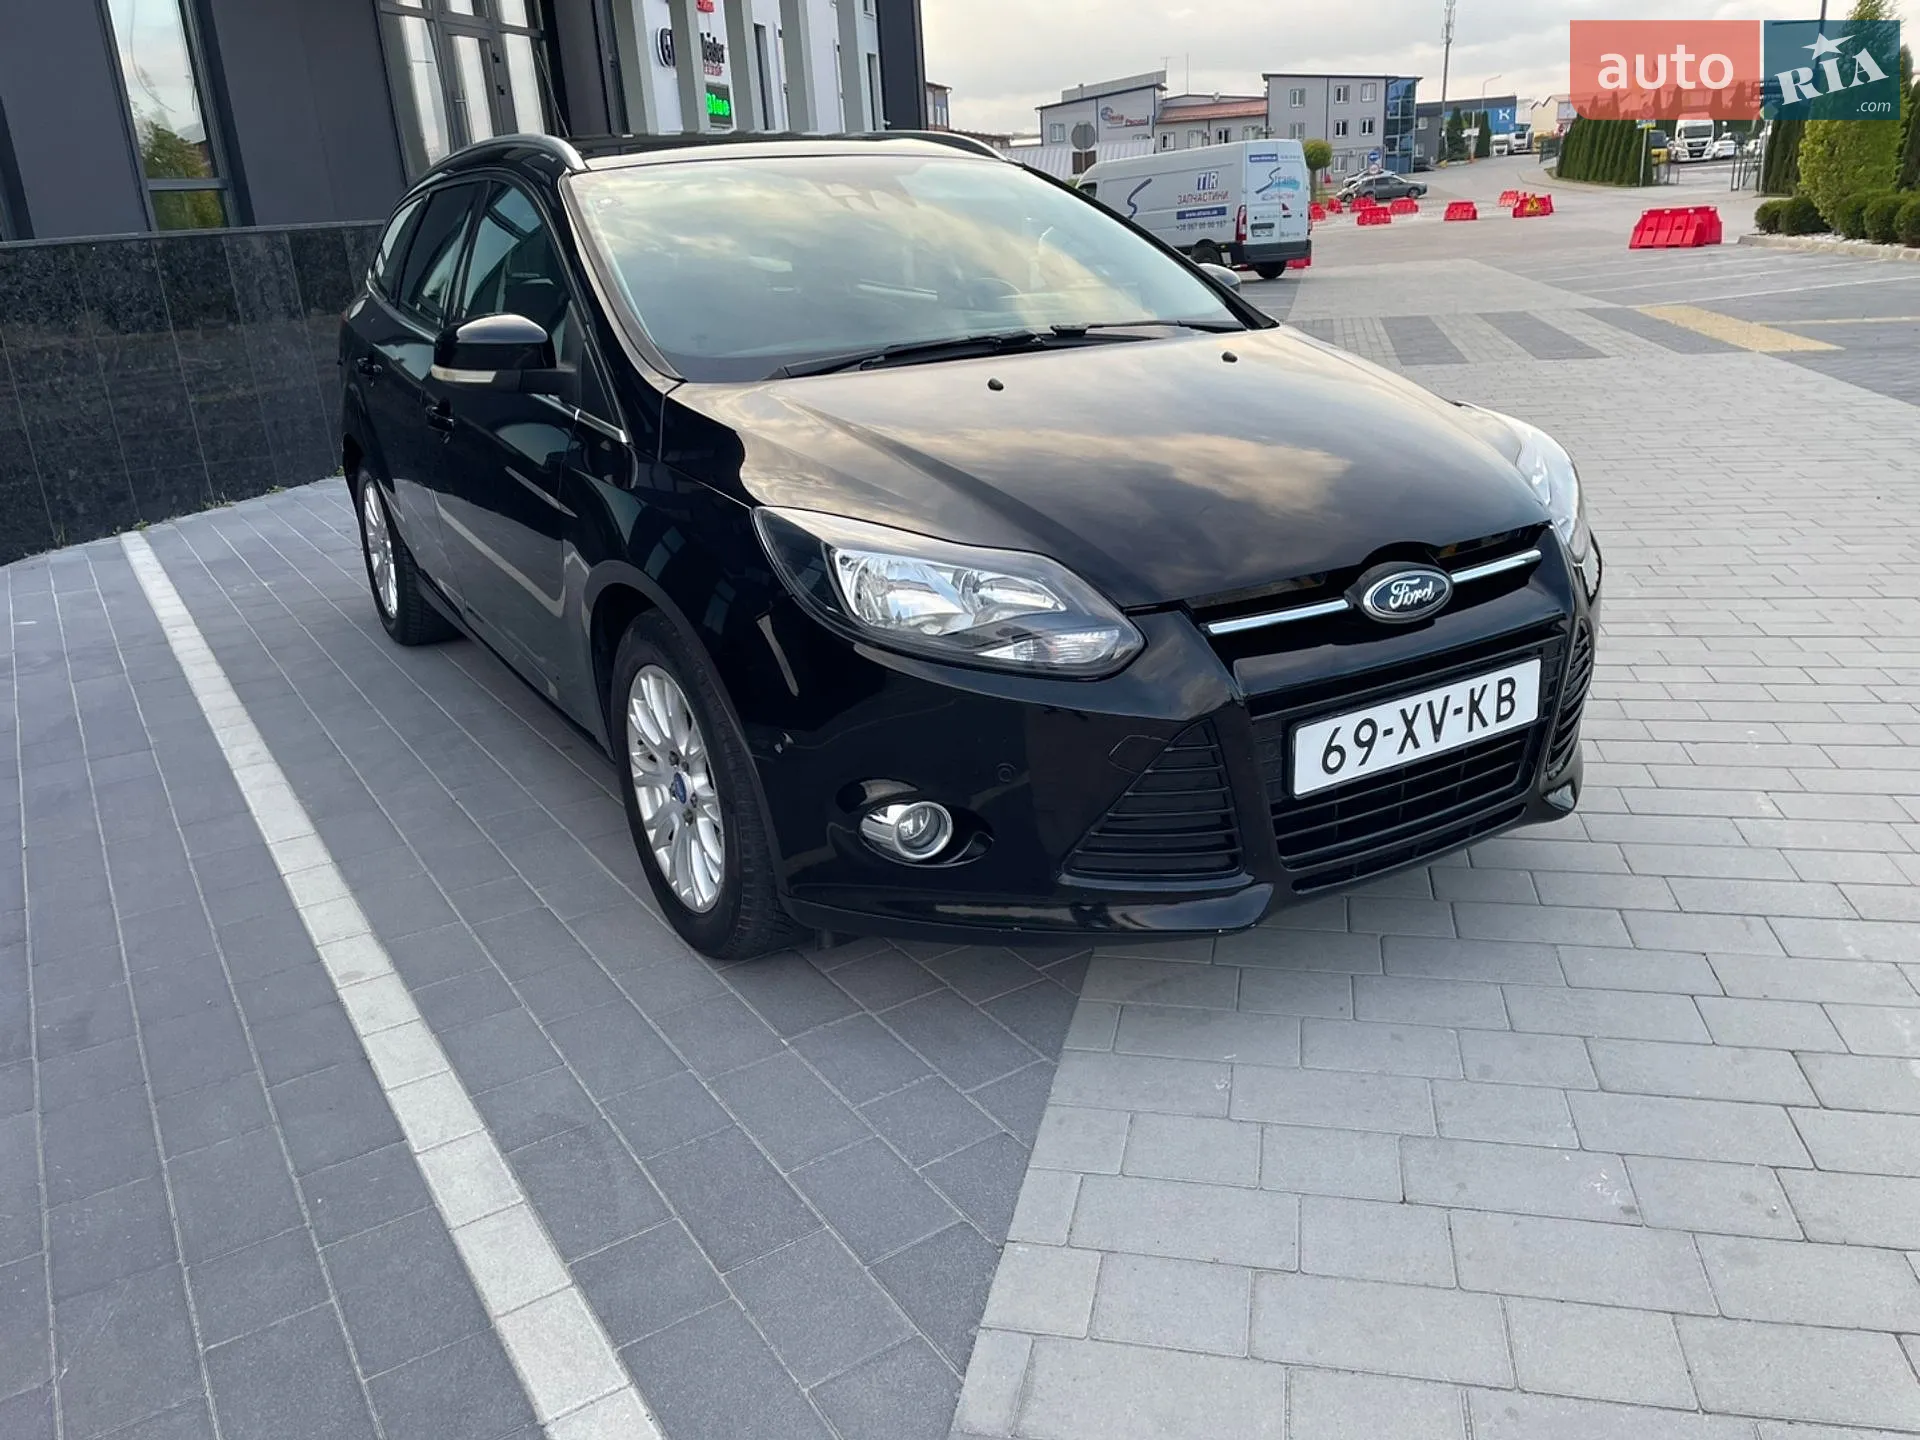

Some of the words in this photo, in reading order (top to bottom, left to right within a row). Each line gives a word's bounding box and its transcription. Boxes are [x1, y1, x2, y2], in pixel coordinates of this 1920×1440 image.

[1197, 170, 1219, 191] TIR
[1177, 190, 1229, 205] ЗАПЧАСТИНИ
[1389, 578, 1435, 610] Ford
[1321, 676, 1516, 776] 69-XV-KB
